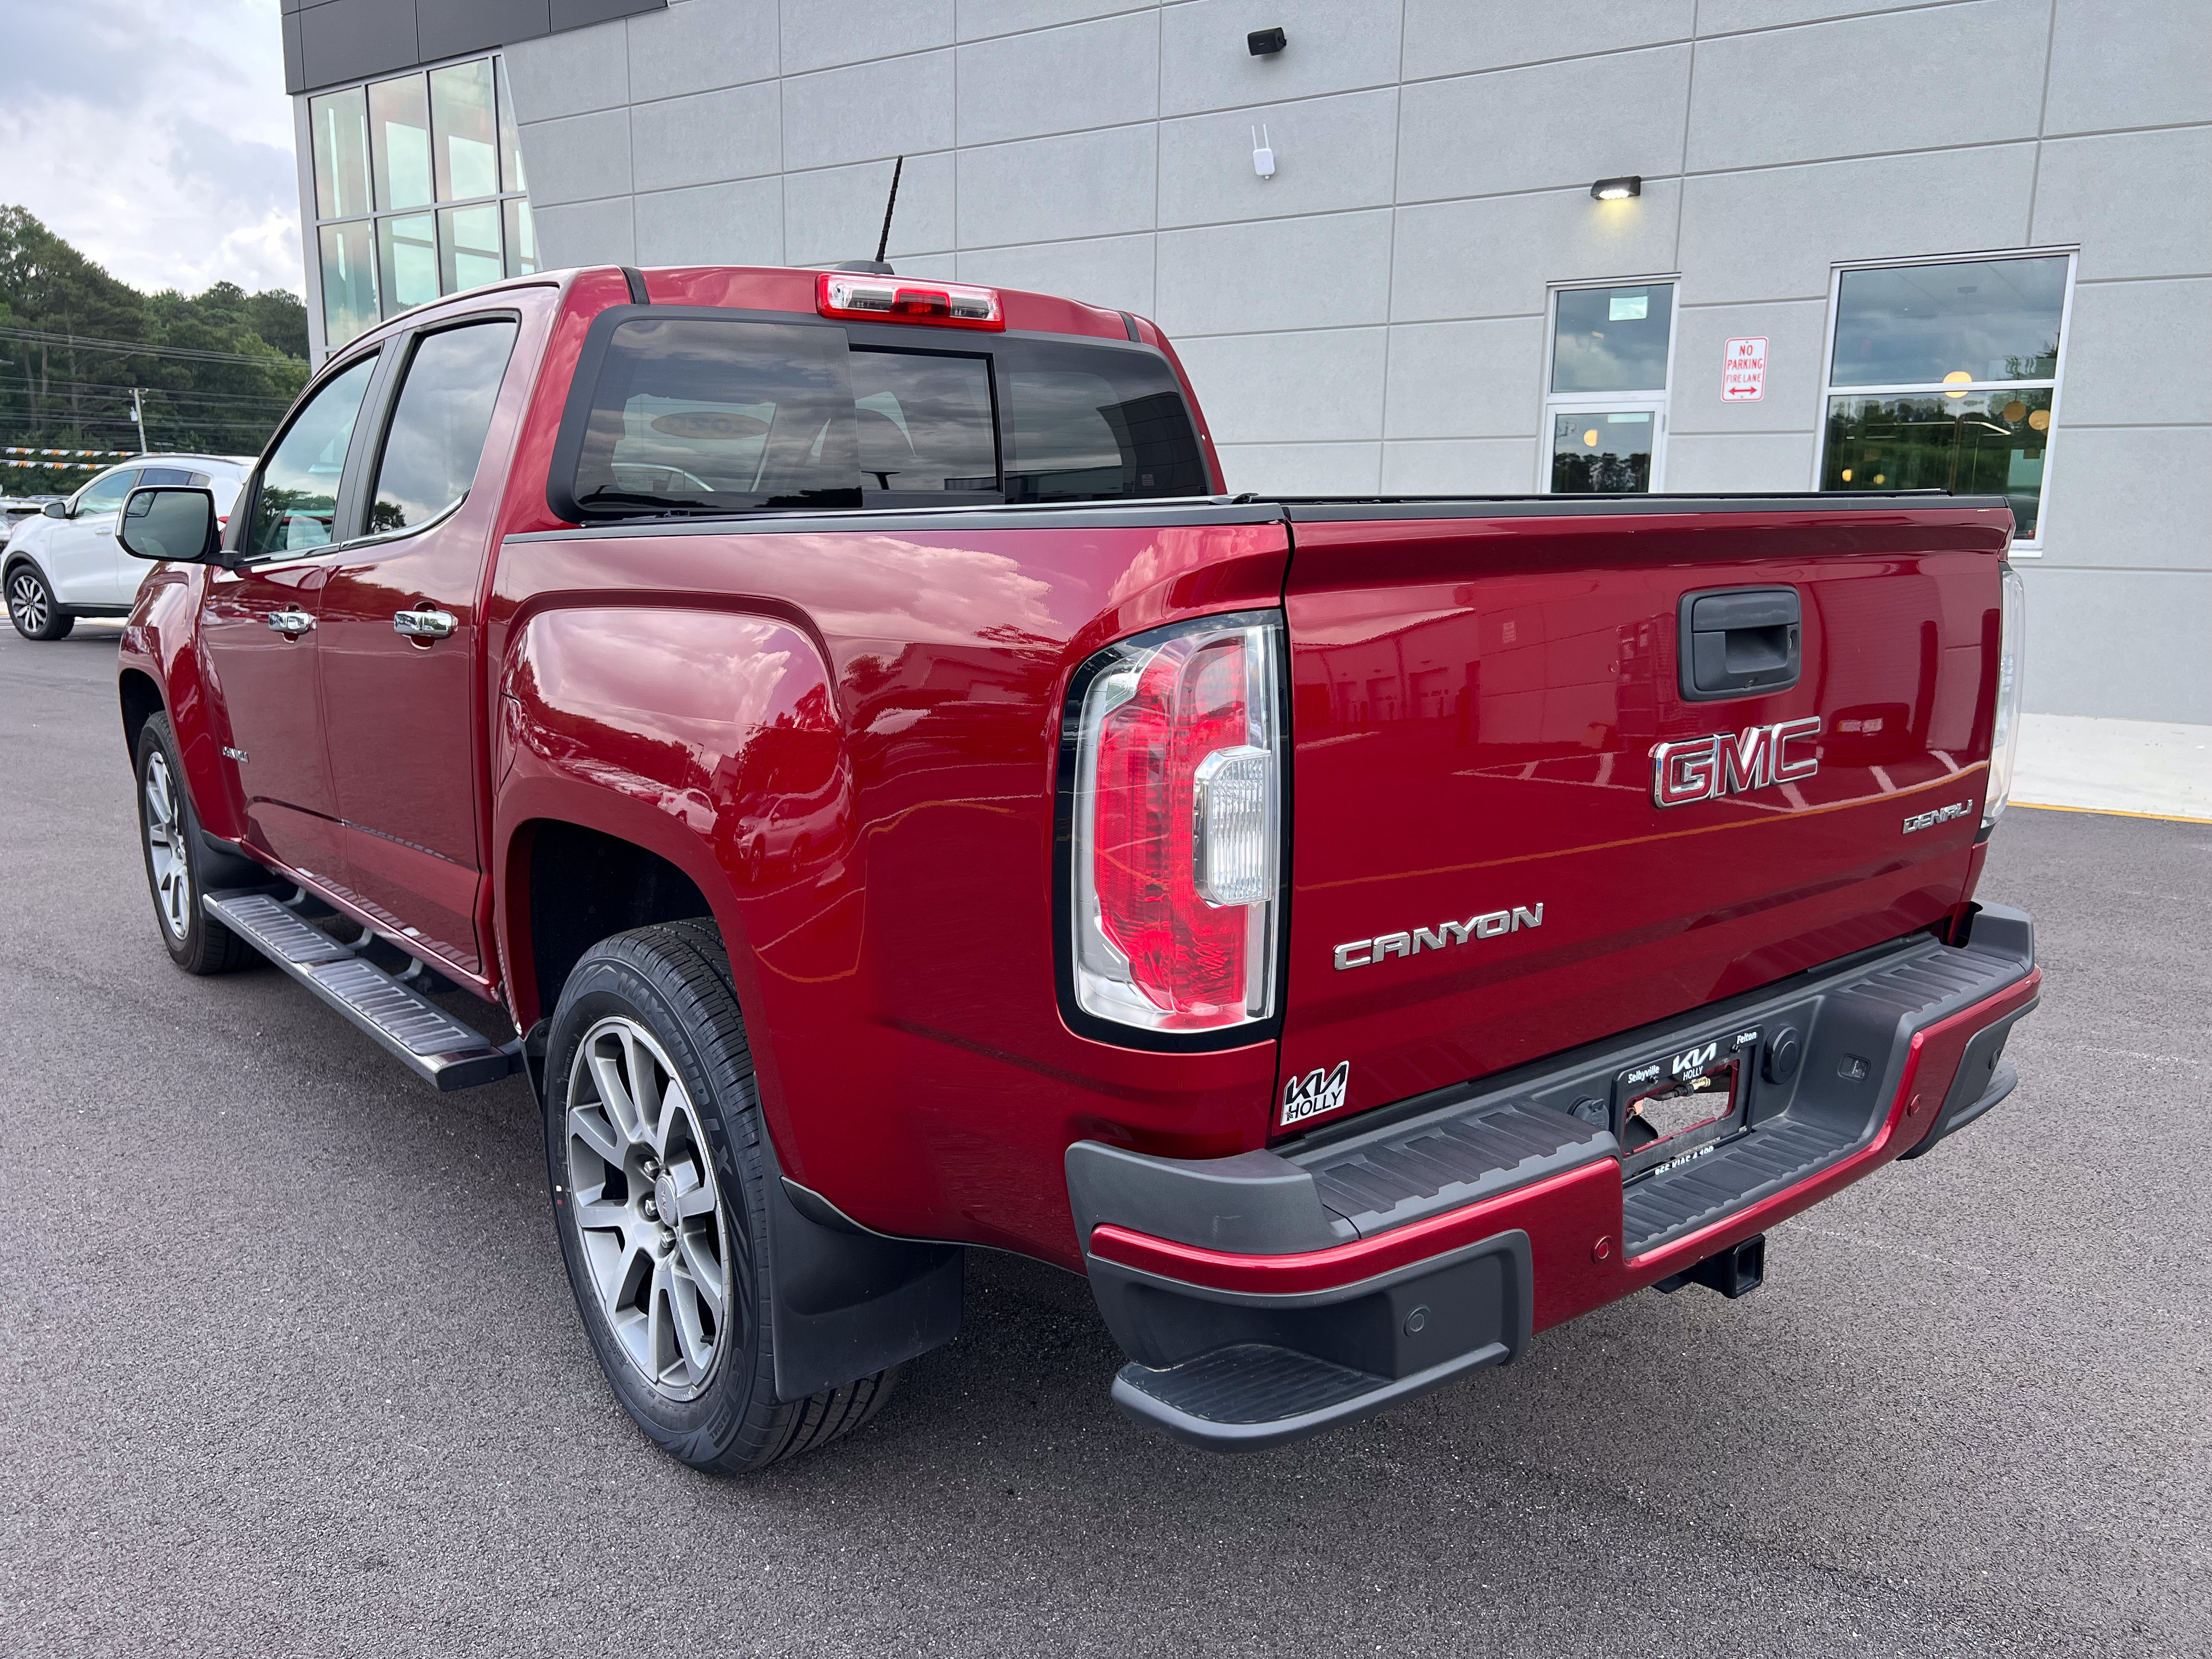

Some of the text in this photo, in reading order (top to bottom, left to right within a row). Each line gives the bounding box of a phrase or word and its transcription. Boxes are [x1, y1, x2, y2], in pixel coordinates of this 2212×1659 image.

[1727, 358, 1763, 370] PARKING
[1739, 345, 1753, 356] NO
[1726, 373, 1761, 383] FIRE LANE
[1649, 715, 1821, 809] GMC
[1901, 799, 1973, 834] DENALI
[1333, 902, 1545, 971] CANYON
[1736, 1031, 1757, 1045] Felton
[617, 971, 733, 1176] MAXTOUR LX
[1627, 1064, 1660, 1085] Selbyville
[1672, 1042, 1717, 1075] KIA
[1683, 1065, 1703, 1081] HOLLY
[1285, 1064, 1348, 1105] KIA
[1286, 1088, 1342, 1121] HOLLY
[708, 1409, 731, 1440] RADIAL
